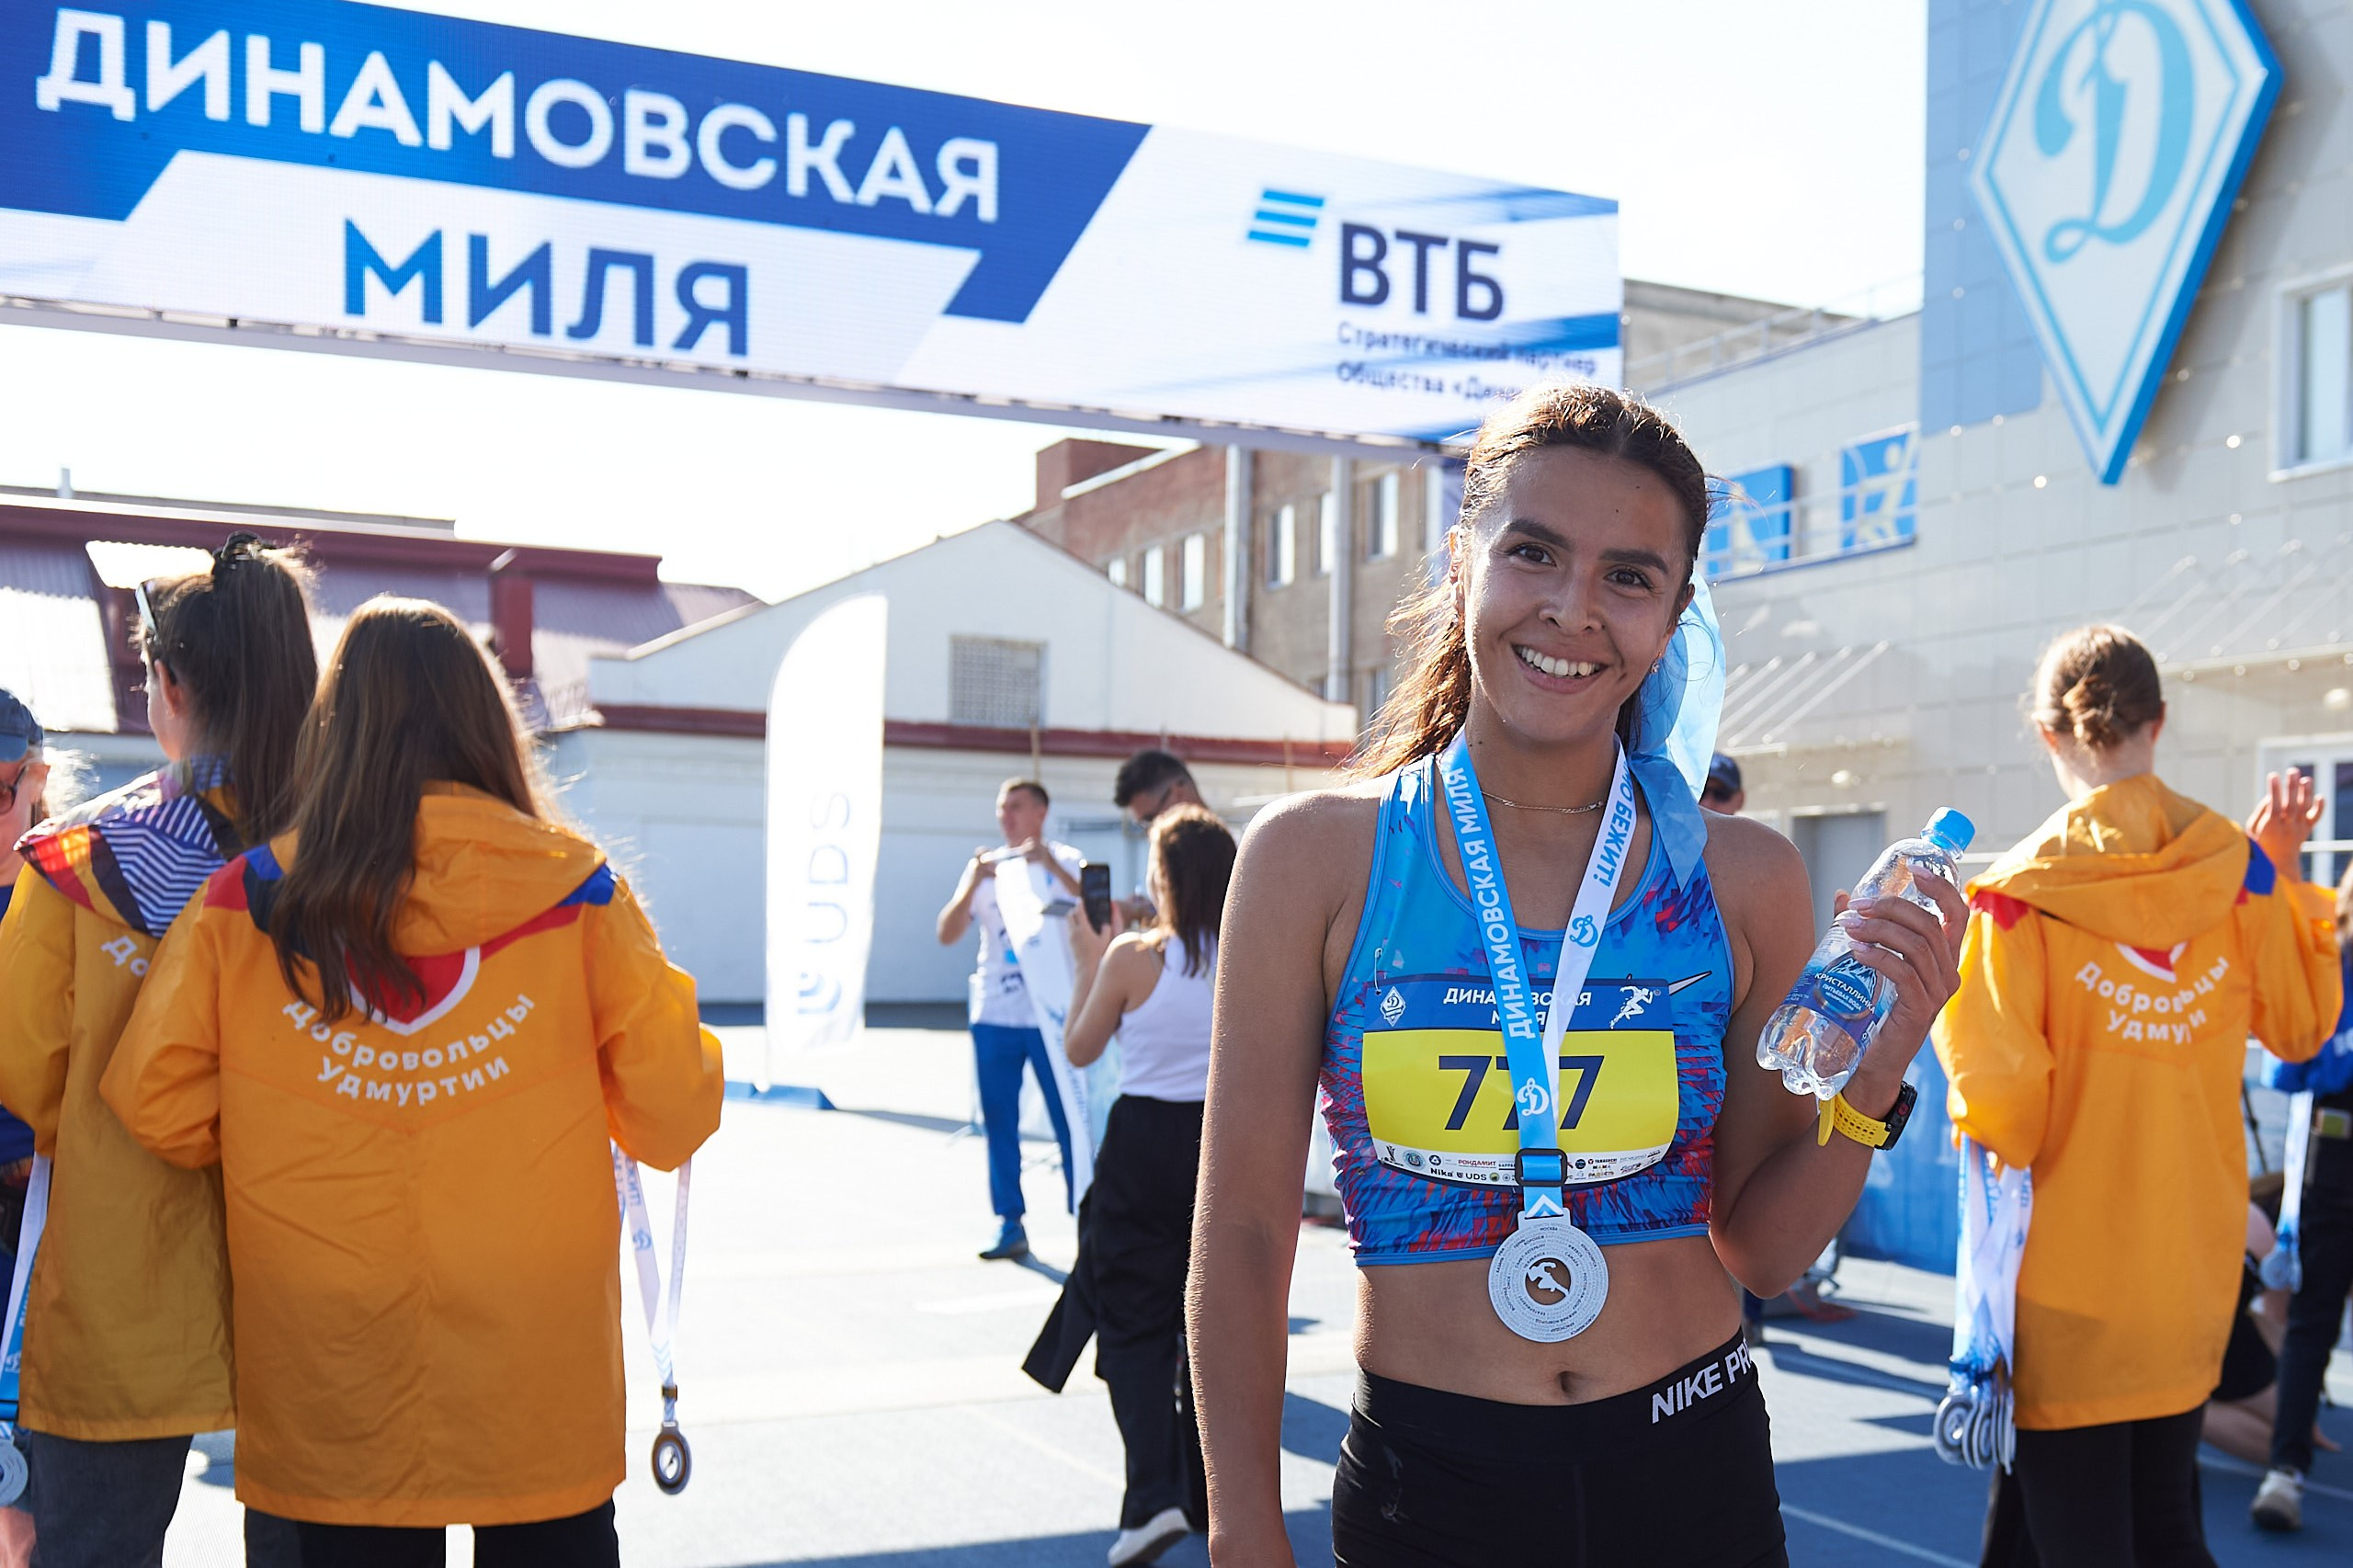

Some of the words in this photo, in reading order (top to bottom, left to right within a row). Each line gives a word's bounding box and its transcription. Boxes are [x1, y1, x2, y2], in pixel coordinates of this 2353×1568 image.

[36, 7, 999, 223] ДИНАМОВСКАЯ
[345, 217, 749, 358] МИЛЯ
[1338, 221, 1506, 322] ВТБ
[1336, 361, 1444, 393] Общества
[1447, 767, 1483, 835] МИЛЯ
[1592, 802, 1633, 888] БЕЖИТ!
[1463, 839, 1537, 1040] ДИНАМОВСКАЯ
[1813, 971, 1876, 1015] КРИСТАЛЛИНКА
[1822, 983, 1850, 1003] ПИТЬЕВАЯ
[1847, 995, 1862, 1011] ВОДА
[282, 994, 535, 1071] Добровольцы
[1465, 1172, 1487, 1181] UDS
[1652, 1361, 1723, 1425] NIKE
